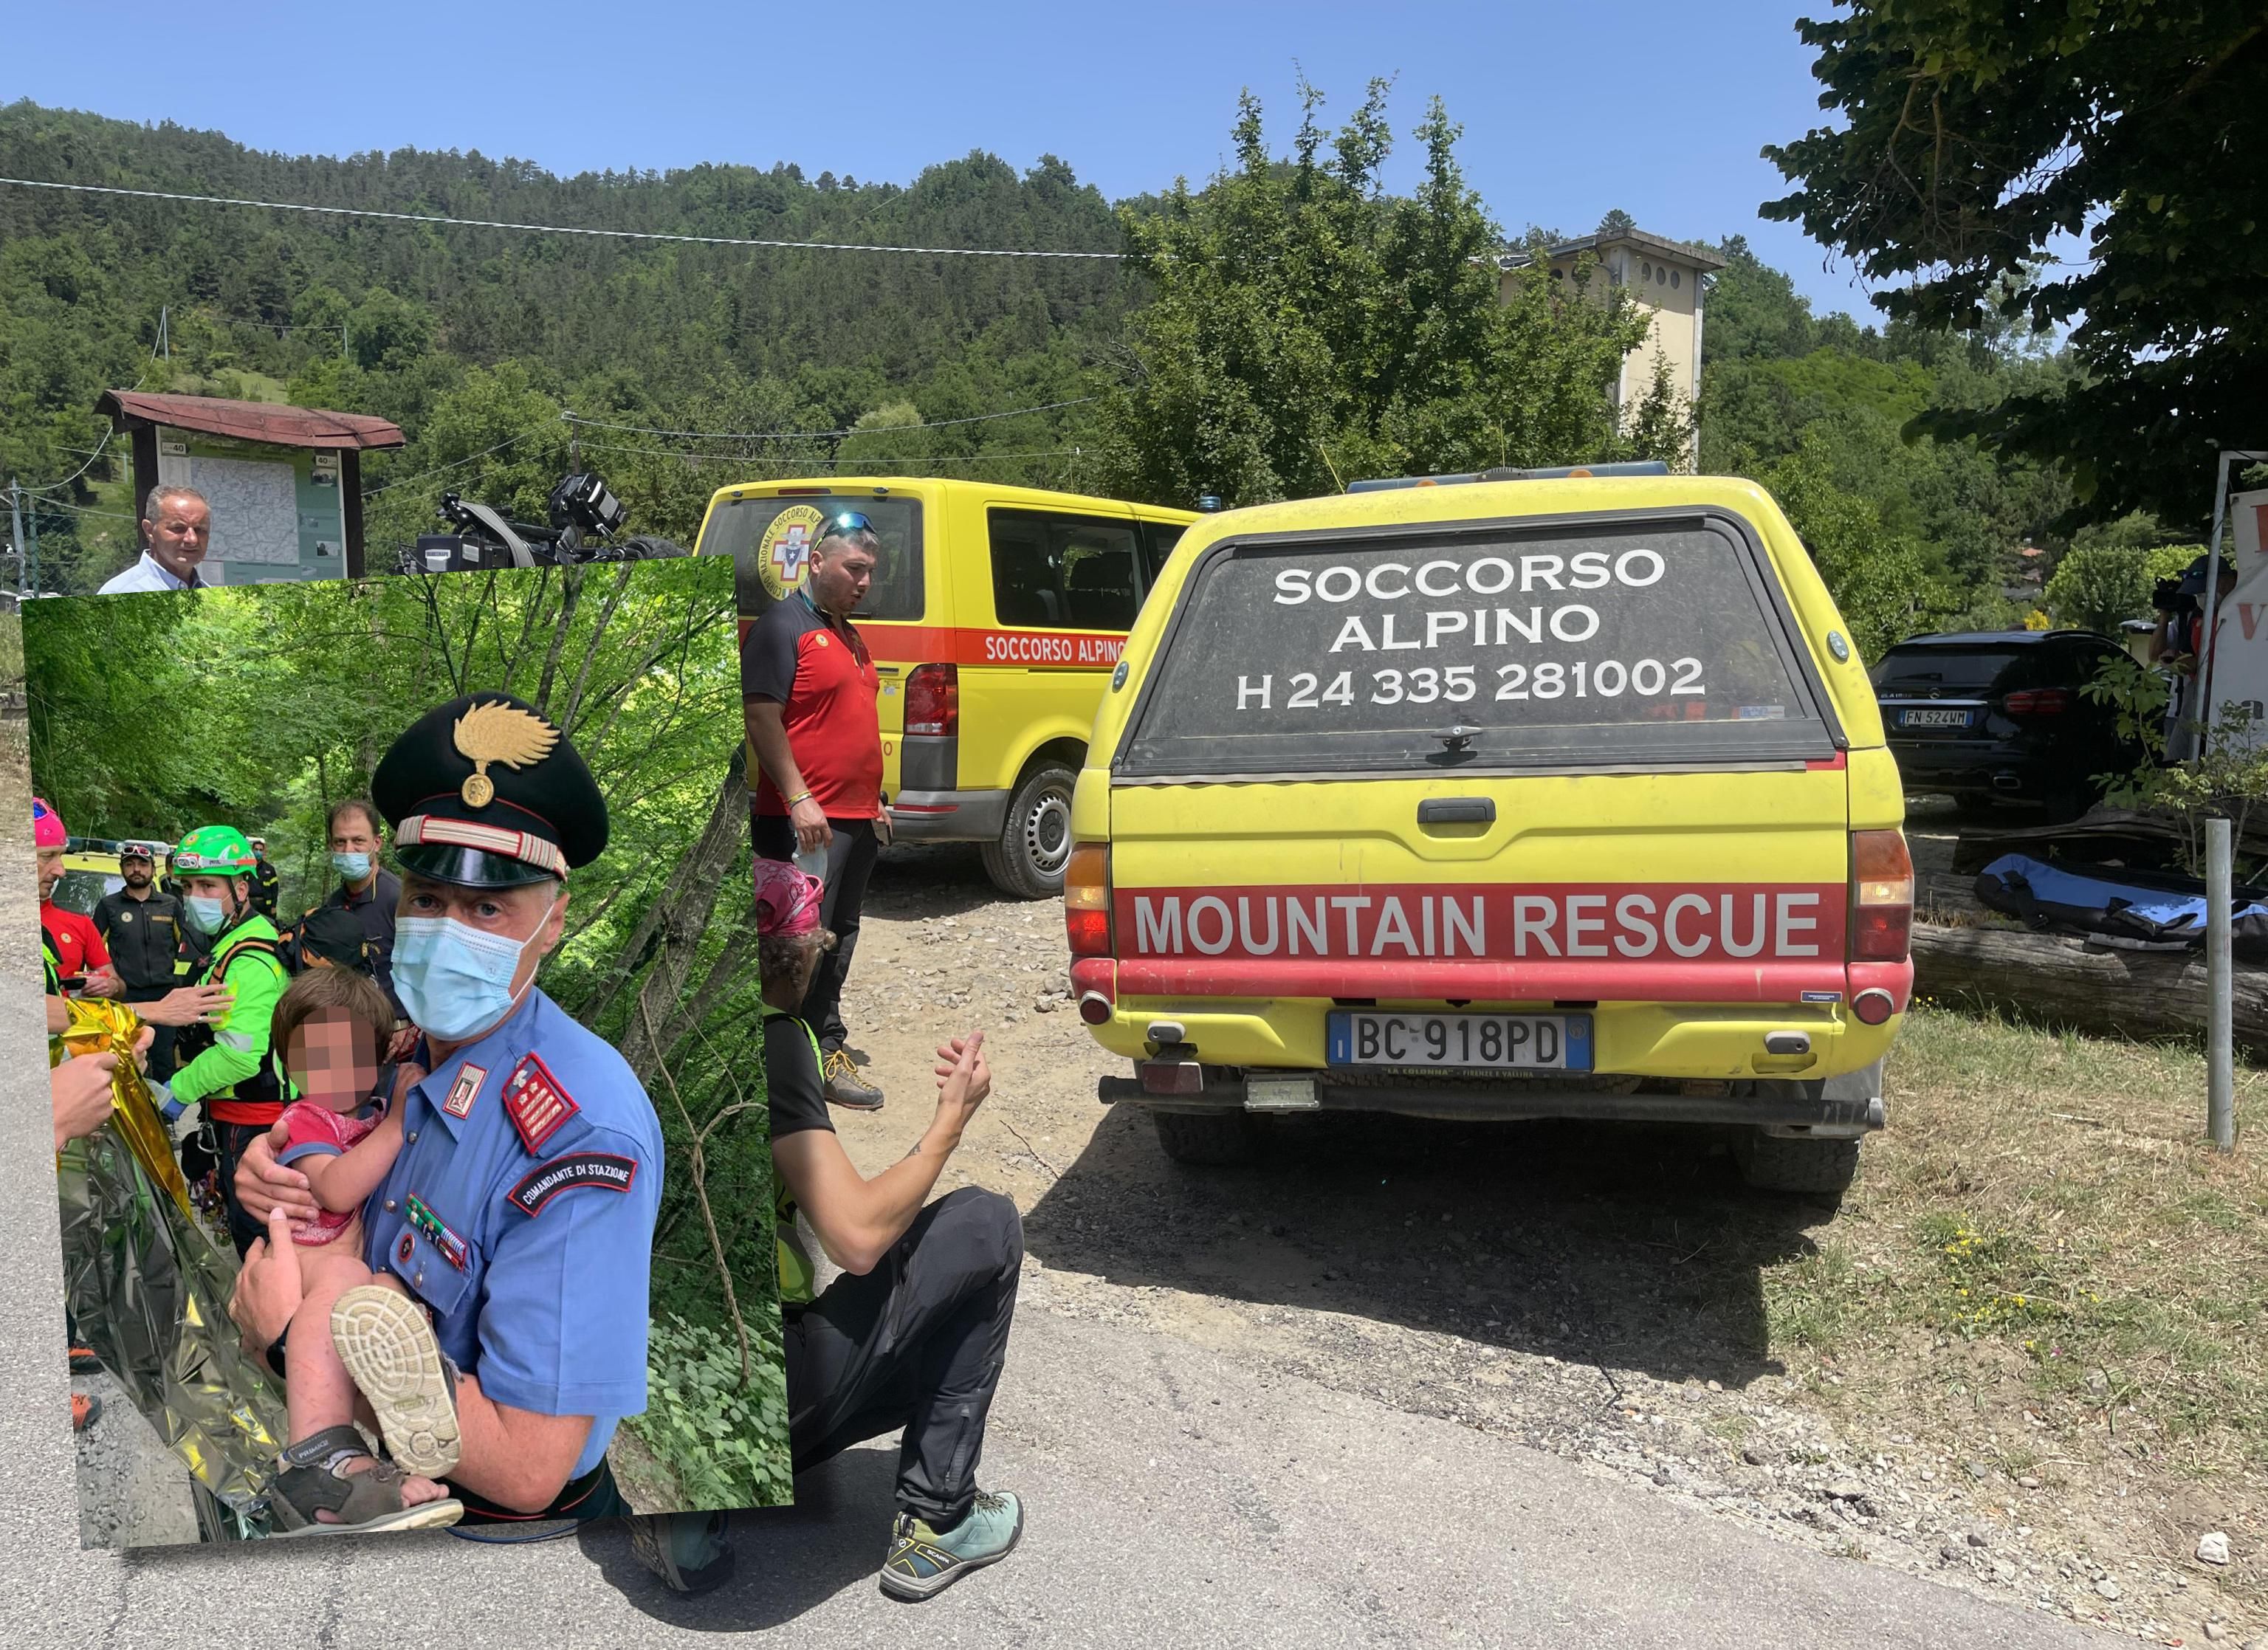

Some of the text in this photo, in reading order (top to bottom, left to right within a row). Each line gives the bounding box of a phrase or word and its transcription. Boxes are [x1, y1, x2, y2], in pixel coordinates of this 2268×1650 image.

[317, 456, 328, 464] 40
[774, 507, 808, 529] SOCCORSO
[759, 529, 775, 575] NAZIONALE
[763, 576, 782, 597] CORPO
[1273, 549, 1666, 605] SOCCORSO
[1328, 604, 1601, 653] ALPINO
[986, 636, 1072, 661] SOCCORSO
[1235, 657, 1705, 709] H 24 335 281002
[1906, 711, 1922, 723] FN
[1925, 712, 1966, 724] 524WM
[1135, 893, 1820, 958] MOUNTAIN RESCUE
[523, 1163, 630, 1206] COMANDANTE DI STAZIONE
[926, 1549, 950, 1564] SCARPA
